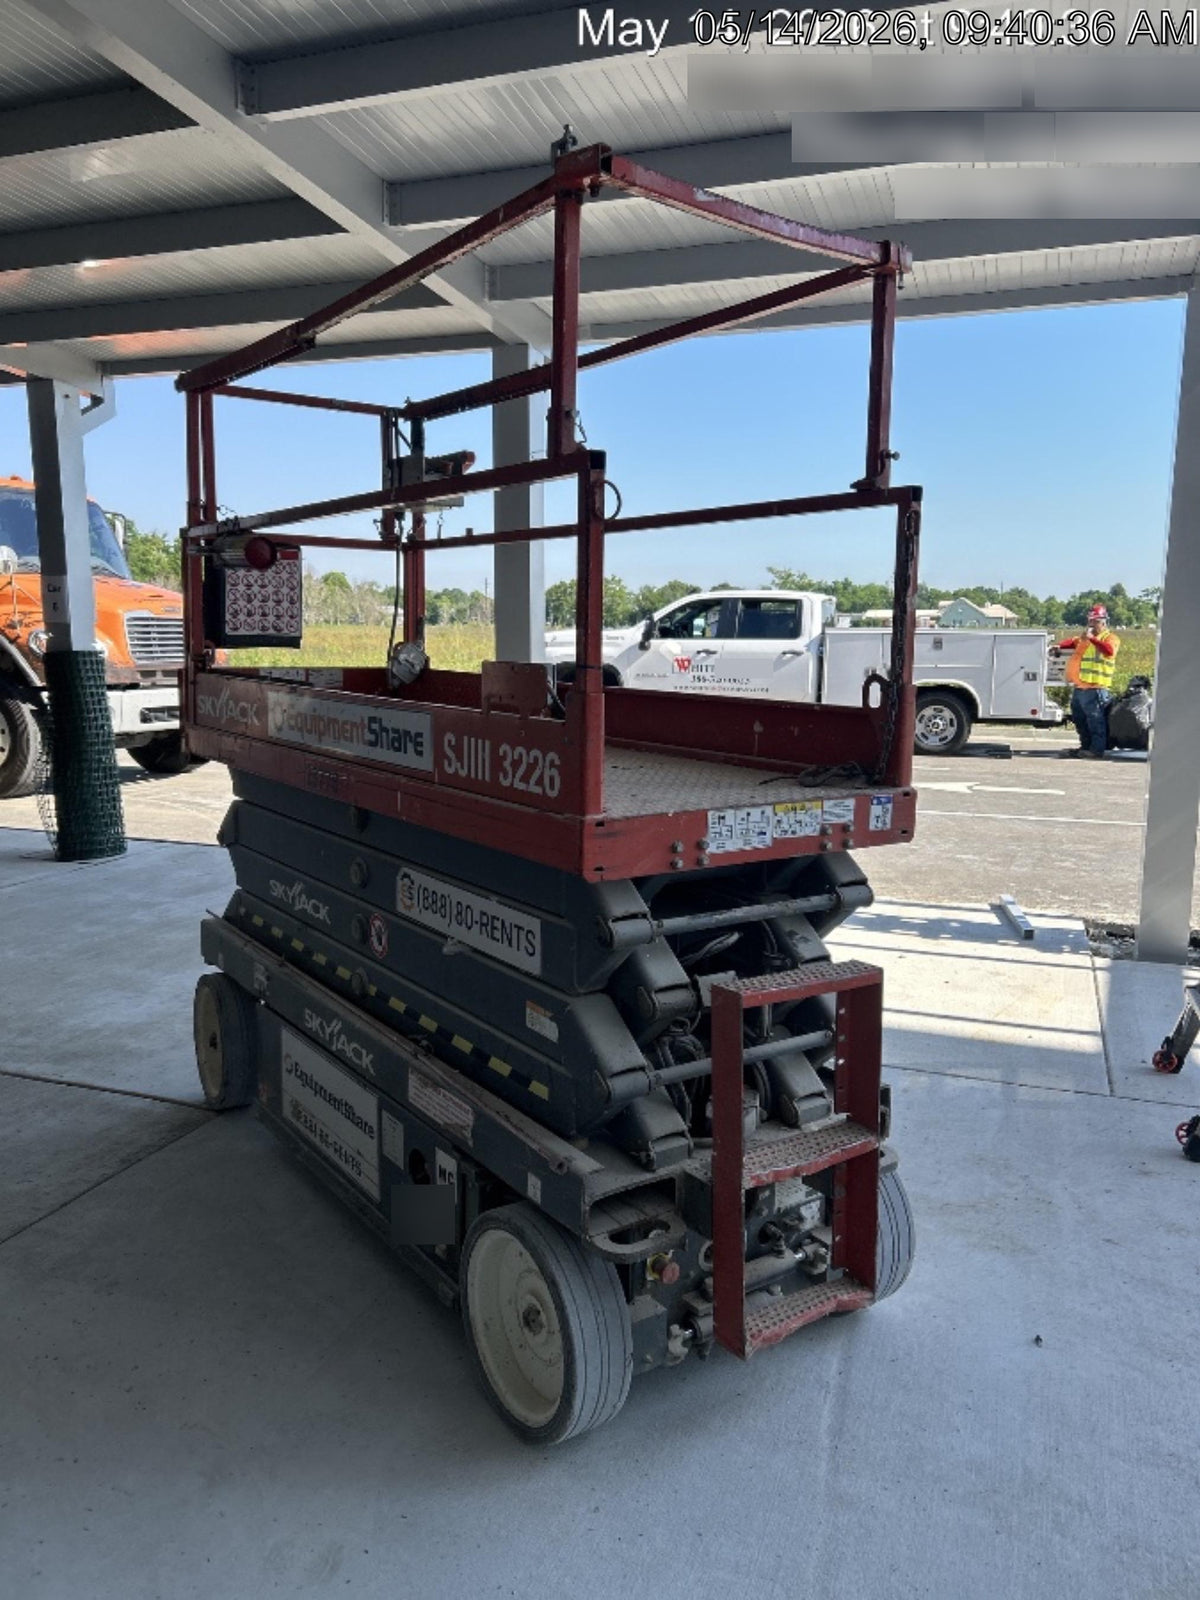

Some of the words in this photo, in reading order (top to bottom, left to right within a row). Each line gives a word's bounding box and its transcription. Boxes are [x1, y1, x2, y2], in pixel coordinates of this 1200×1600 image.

[198, 687, 260, 726] SKYJACK
[498, 742, 561, 800] 3226
[269, 879, 332, 925] SKYJACK
[417, 884, 453, 928] (888)
[455, 901, 536, 957] 80-RENTS
[304, 1006, 376, 1077] SKYJACK
